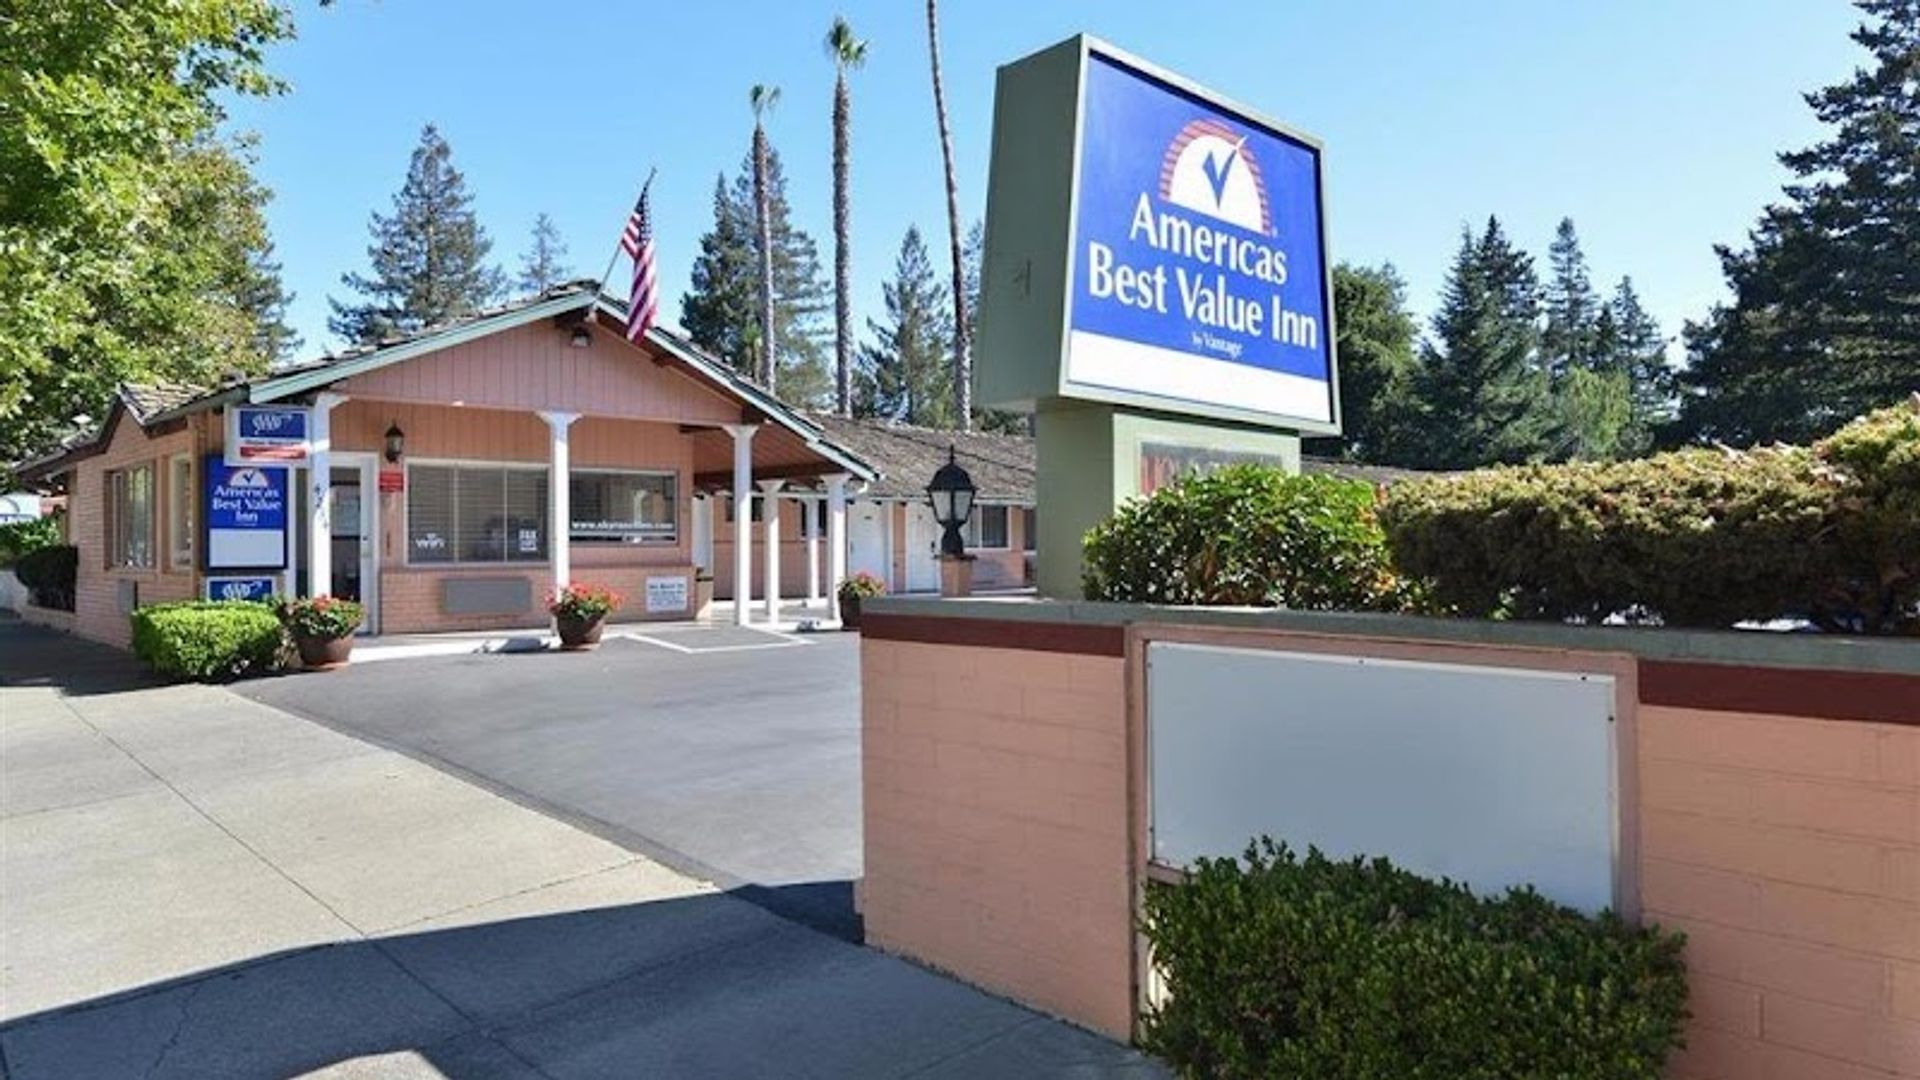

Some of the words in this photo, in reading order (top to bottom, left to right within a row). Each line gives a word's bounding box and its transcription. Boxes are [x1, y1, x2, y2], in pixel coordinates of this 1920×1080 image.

[1129, 191, 1288, 286] Americas
[1088, 240, 1168, 314] Best
[1175, 267, 1263, 338] Value
[1271, 294, 1317, 350] Inn
[213, 484, 280, 498] Americas
[212, 497, 241, 511] Best
[244, 498, 283, 511] Value
[235, 510, 259, 523] Inn
